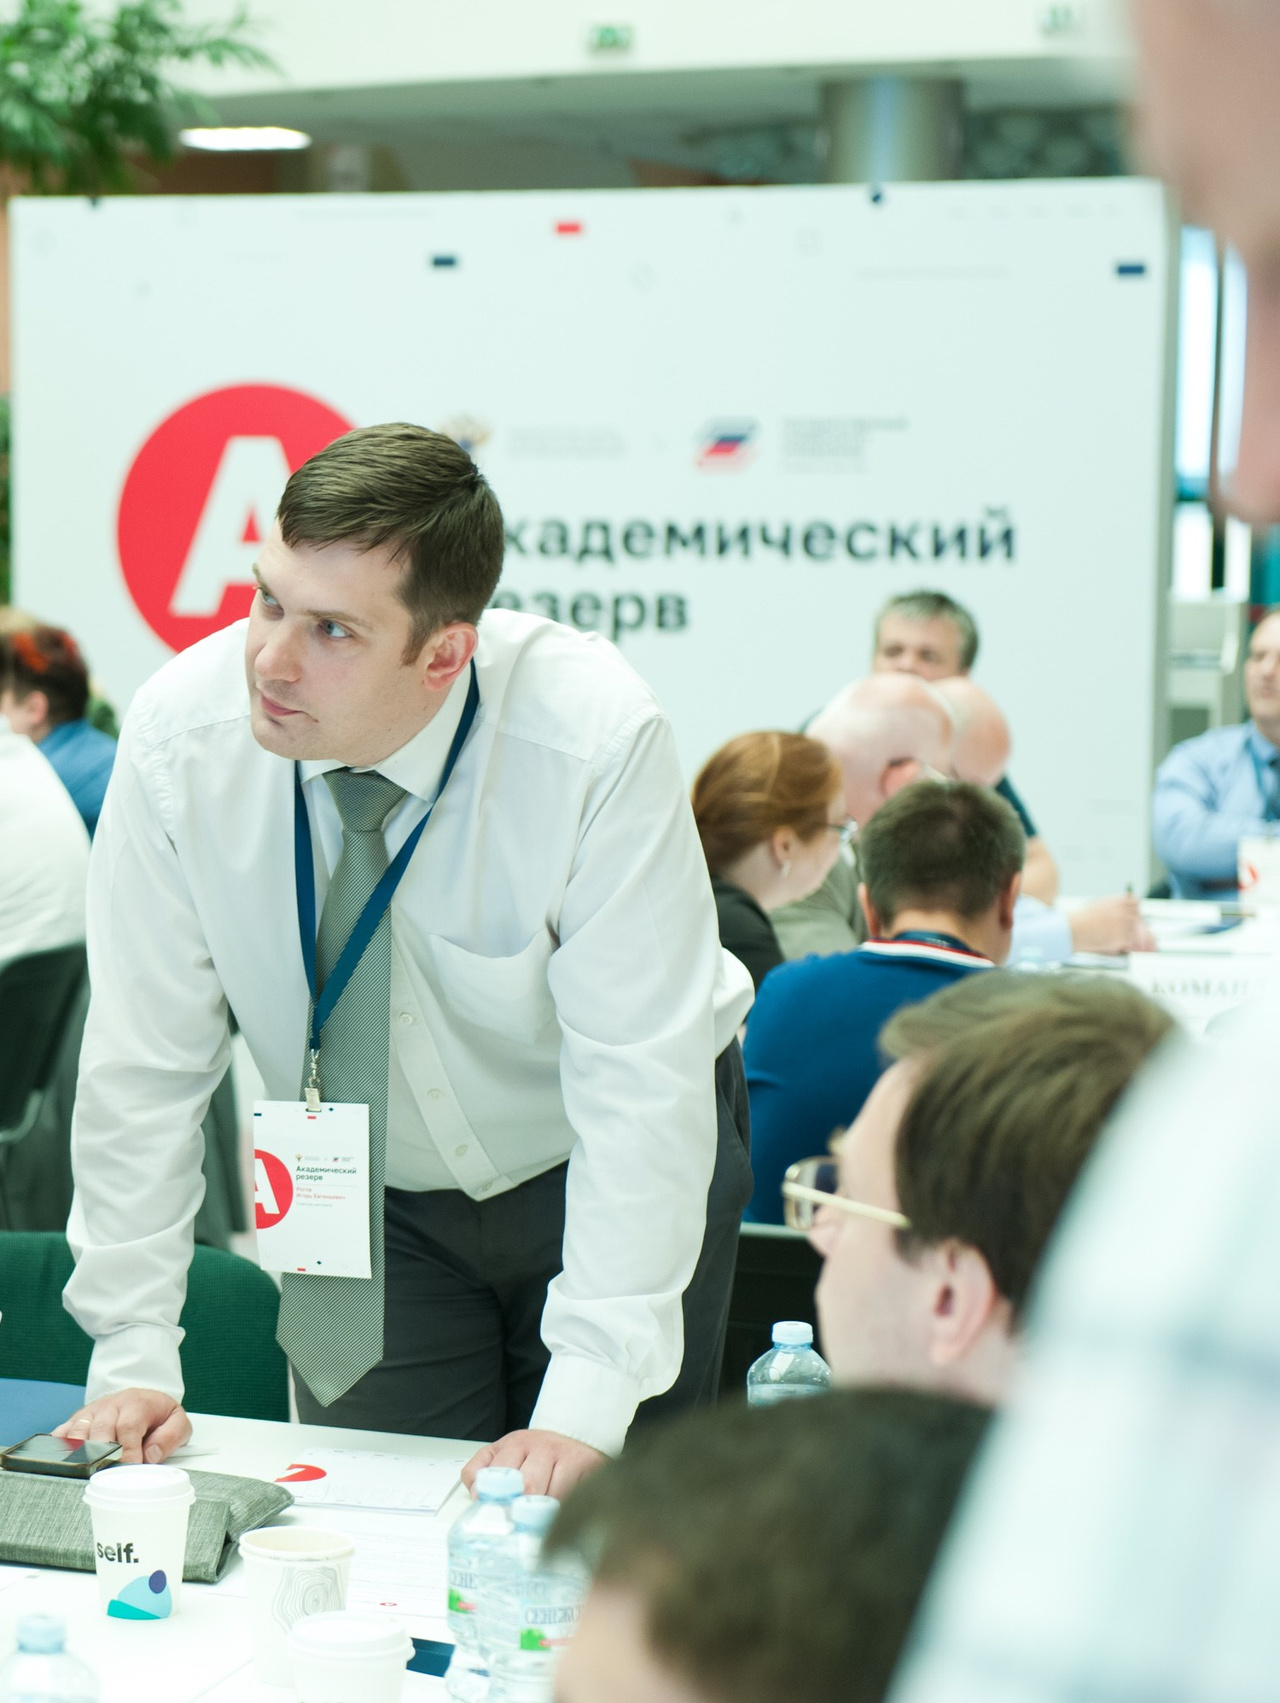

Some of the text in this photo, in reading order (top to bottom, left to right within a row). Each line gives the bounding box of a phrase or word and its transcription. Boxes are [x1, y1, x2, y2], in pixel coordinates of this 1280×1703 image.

[504, 504, 1016, 563] кадемический
[491, 591, 687, 642] зерв
[1152, 977, 1266, 996] КОМАН
[296, 1166, 357, 1174] Академический
[97, 1542, 140, 1563] self.
[525, 1607, 581, 1625] СЕНЕЖС
